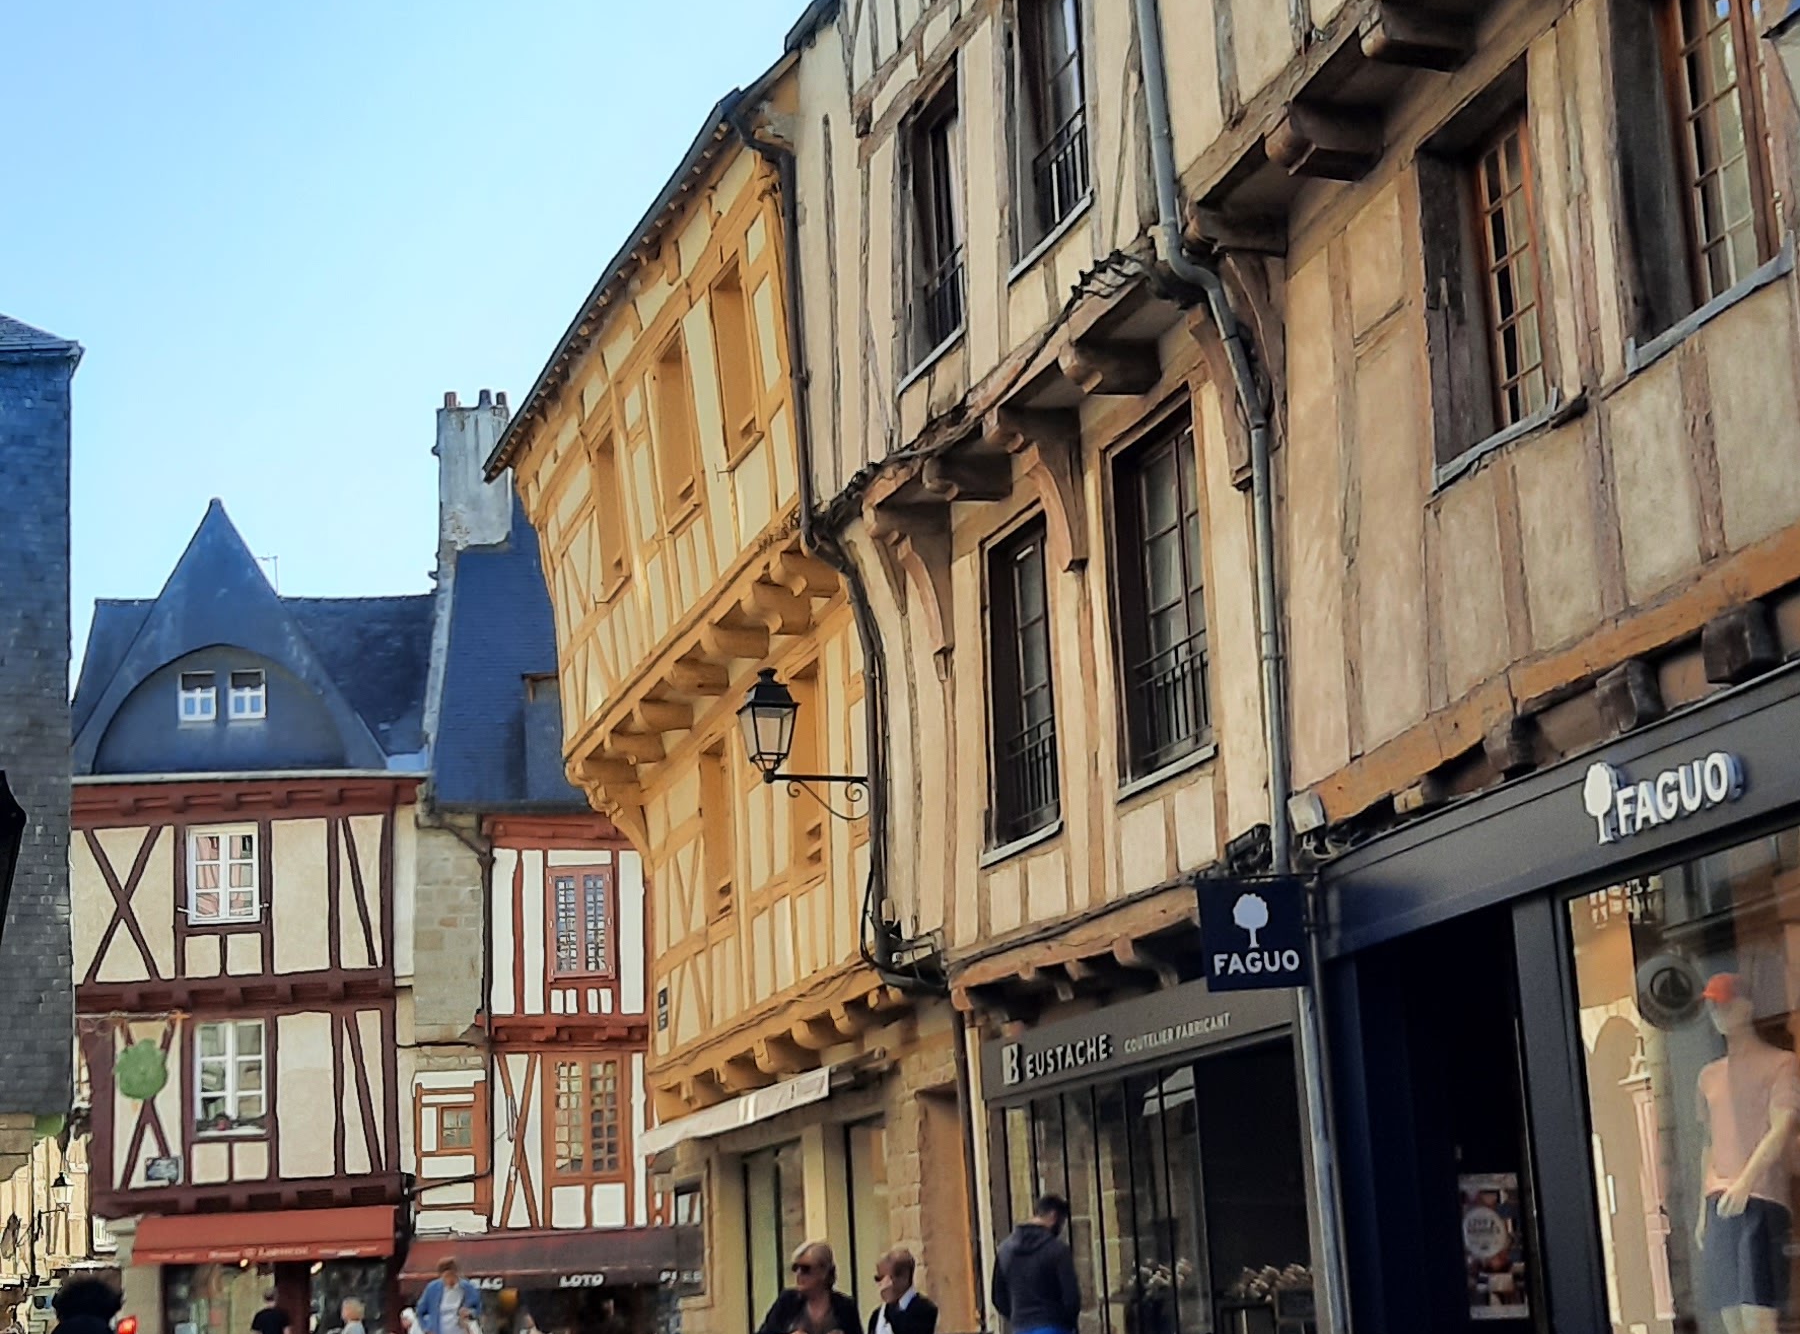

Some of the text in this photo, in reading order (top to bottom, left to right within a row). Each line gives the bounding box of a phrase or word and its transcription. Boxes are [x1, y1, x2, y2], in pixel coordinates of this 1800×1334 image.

[1616, 751, 1738, 837] FAGUO
[1213, 949, 1300, 976] FAGUO
[1175, 1012, 1231, 1039] FABRICANT
[559, 1273, 604, 1288] LOTO
